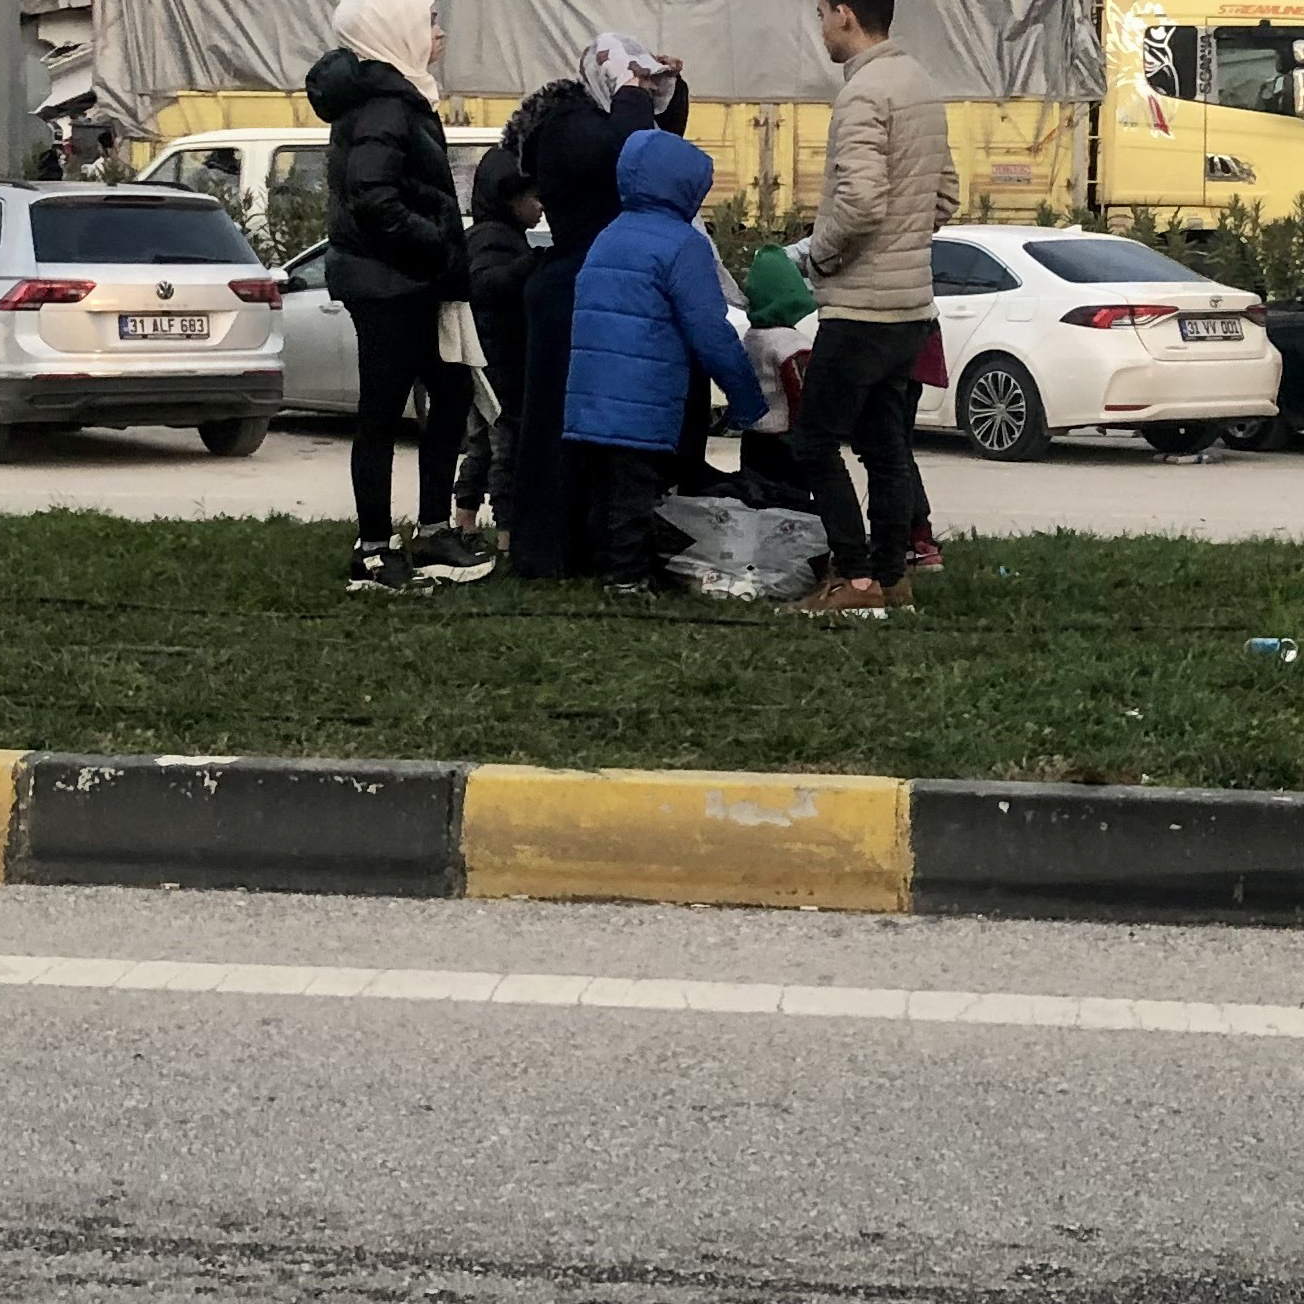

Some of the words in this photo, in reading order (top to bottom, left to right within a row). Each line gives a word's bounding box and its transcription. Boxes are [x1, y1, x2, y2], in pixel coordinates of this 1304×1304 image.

[130, 318, 145, 333] 31
[152, 318, 175, 333] ALF
[1187, 321, 1200, 335] 31
